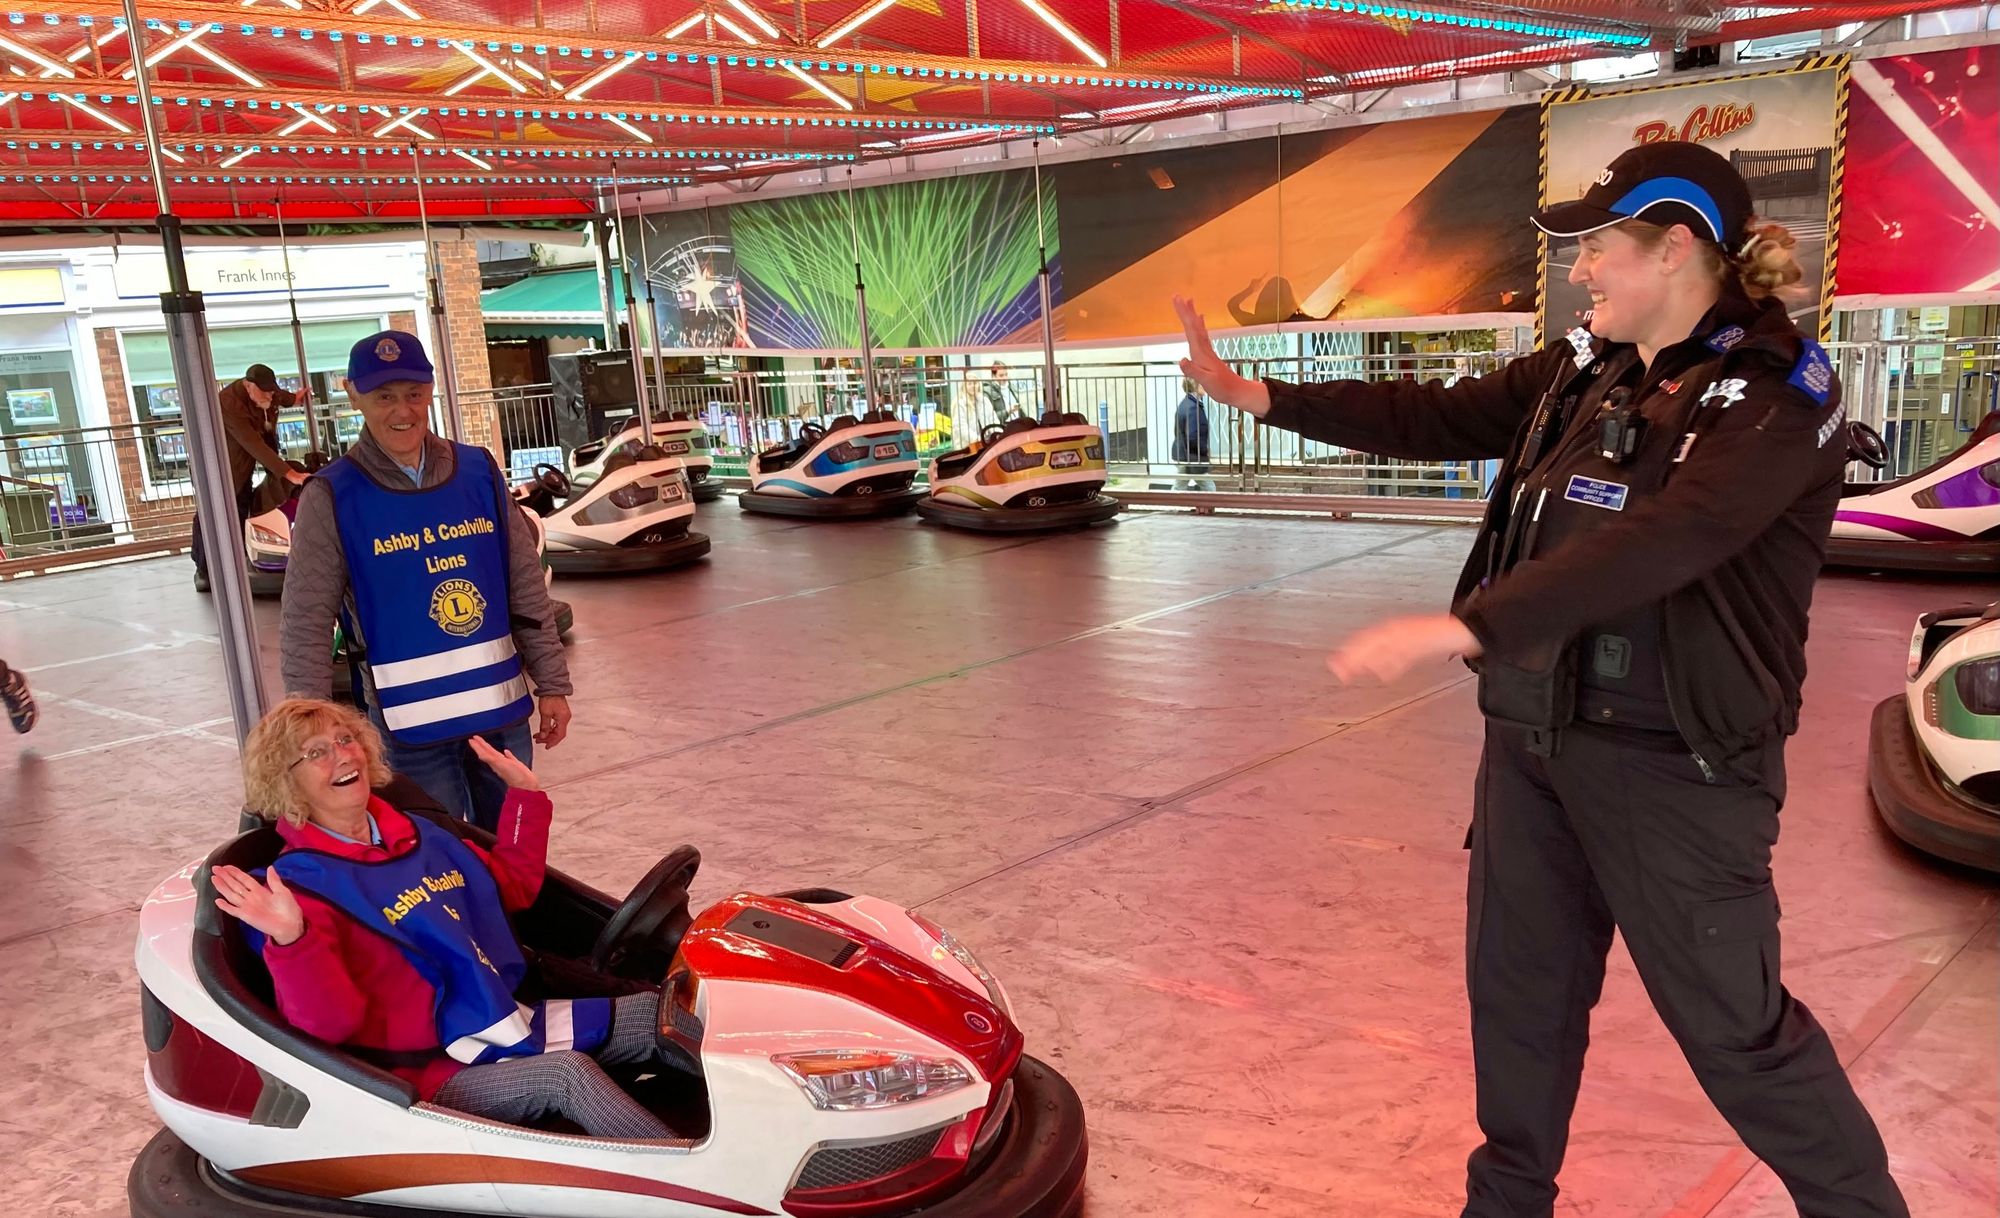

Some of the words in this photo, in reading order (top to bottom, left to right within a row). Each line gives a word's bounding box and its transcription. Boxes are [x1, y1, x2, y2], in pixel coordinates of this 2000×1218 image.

[1678, 102, 1755, 146] Collins
[217, 269, 257, 283] Frank
[261, 268, 296, 282] Innes
[1710, 327, 1744, 345] PCSO
[670, 443, 686, 451] 03
[666, 486, 678, 496] 12
[1571, 485, 1599, 495] COMMUNITY
[1599, 490, 1623, 500] SUPPORT
[1589, 482, 1607, 491] POLICE
[1582, 494, 1605, 503] OFFICER
[374, 532, 420, 556] Ashby
[423, 527, 436, 544] &
[438, 517, 494, 541] Coalville
[425, 553, 467, 574] Lions
[436, 581, 471, 597] LIONS
[449, 597, 469, 617] L
[382, 885, 431, 926] Ashby
